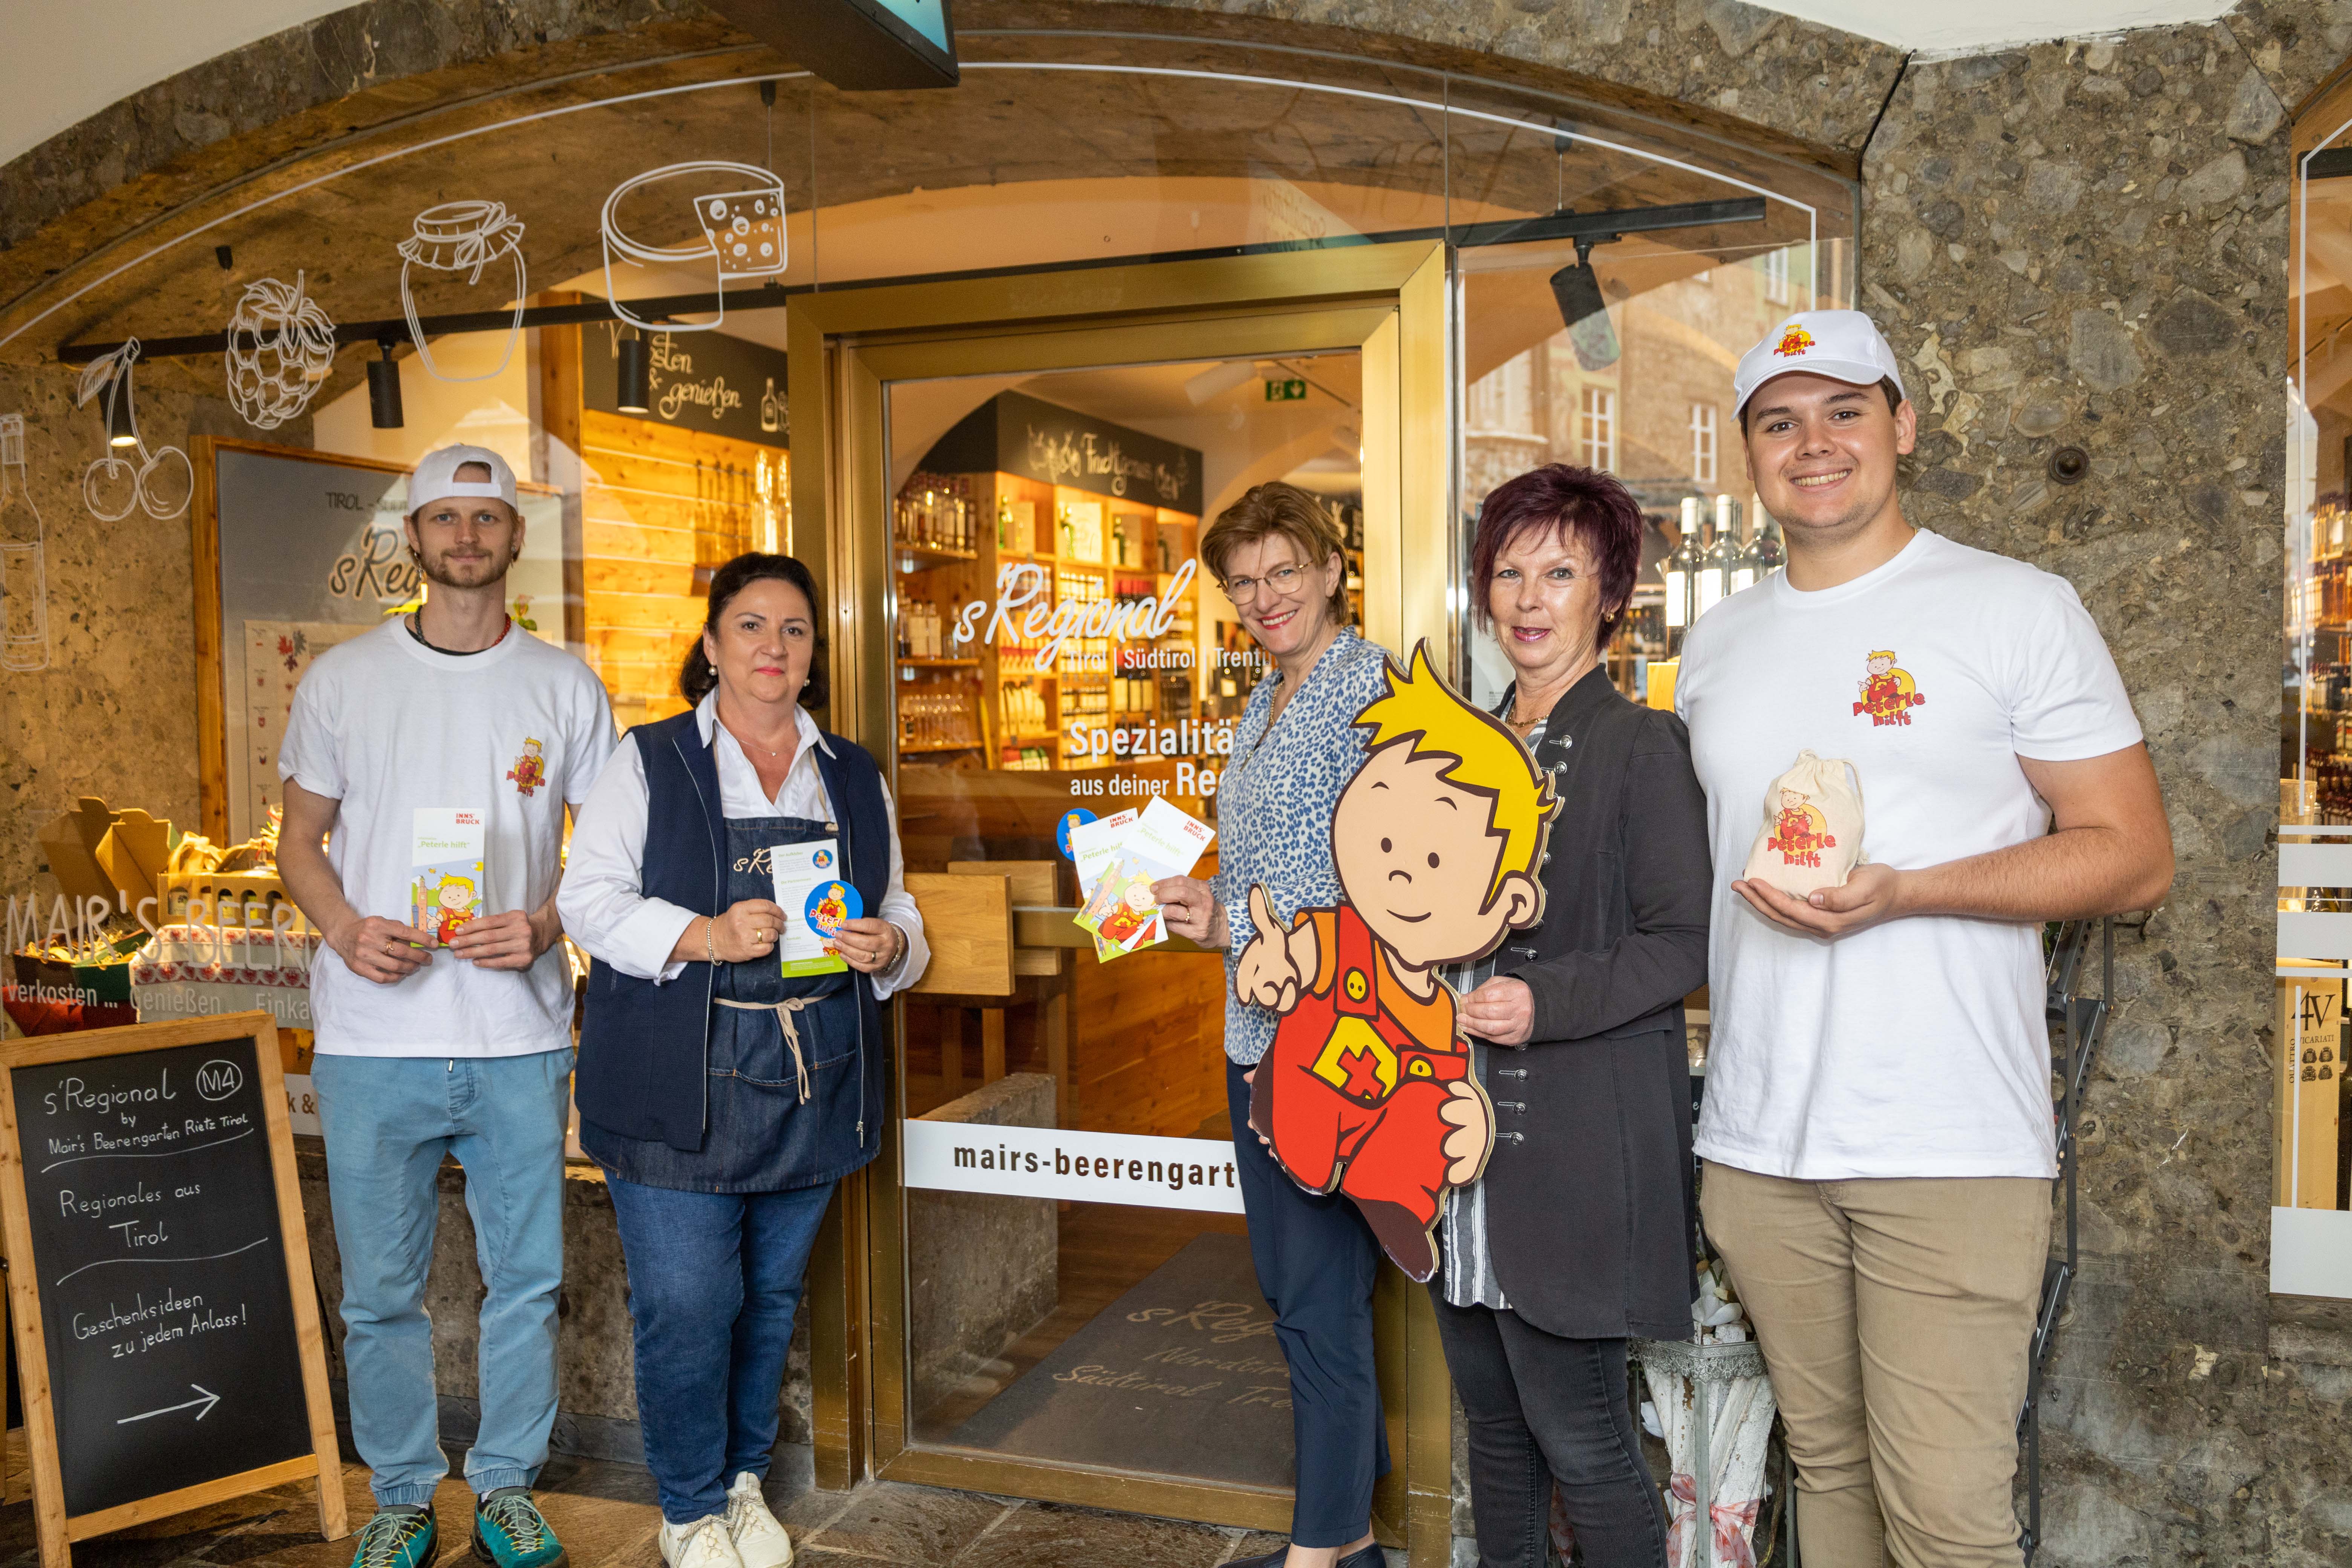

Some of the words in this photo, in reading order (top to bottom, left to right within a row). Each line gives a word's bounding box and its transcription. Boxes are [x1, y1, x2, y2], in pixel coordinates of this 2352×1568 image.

[659, 376, 742, 420] genießen
[325, 492, 363, 510] TIROL
[1066, 649, 1107, 670] Tirol
[1124, 648, 1195, 669] Südtirol
[1873, 710, 1911, 726] hilft
[1070, 719, 1233, 763] Spezialitä
[1070, 779, 1104, 796] aus
[1109, 773, 1169, 796] deiner
[1110, 817, 1133, 828] BRUCK
[1183, 825, 1206, 841] BRUCK
[1784, 851, 1821, 867] hilft
[5, 889, 162, 963] MAIR'S
[5, 979, 97, 1007] Verkosten
[130, 986, 220, 1014] Genießen
[2291, 990, 2336, 1031] 4V
[44, 1068, 176, 1115] s'Regional
[202, 1067, 235, 1092] M4
[49, 1135, 85, 1155] Mair's
[95, 1122, 180, 1150] Beerengarten
[185, 1117, 216, 1136] Rietz
[220, 1113, 249, 1128] Tirol
[121, 1112, 136, 1128] by
[954, 1143, 1234, 1190] mairs-beerengart
[60, 1182, 161, 1218] Regionales
[175, 1184, 200, 1197] aus
[109, 1220, 168, 1247] Tirol
[73, 1287, 203, 1339] Geschenksideen
[112, 1340, 135, 1358] zu
[140, 1323, 183, 1352] jedem
[1052, 1365, 1222, 1397] Südtirol
